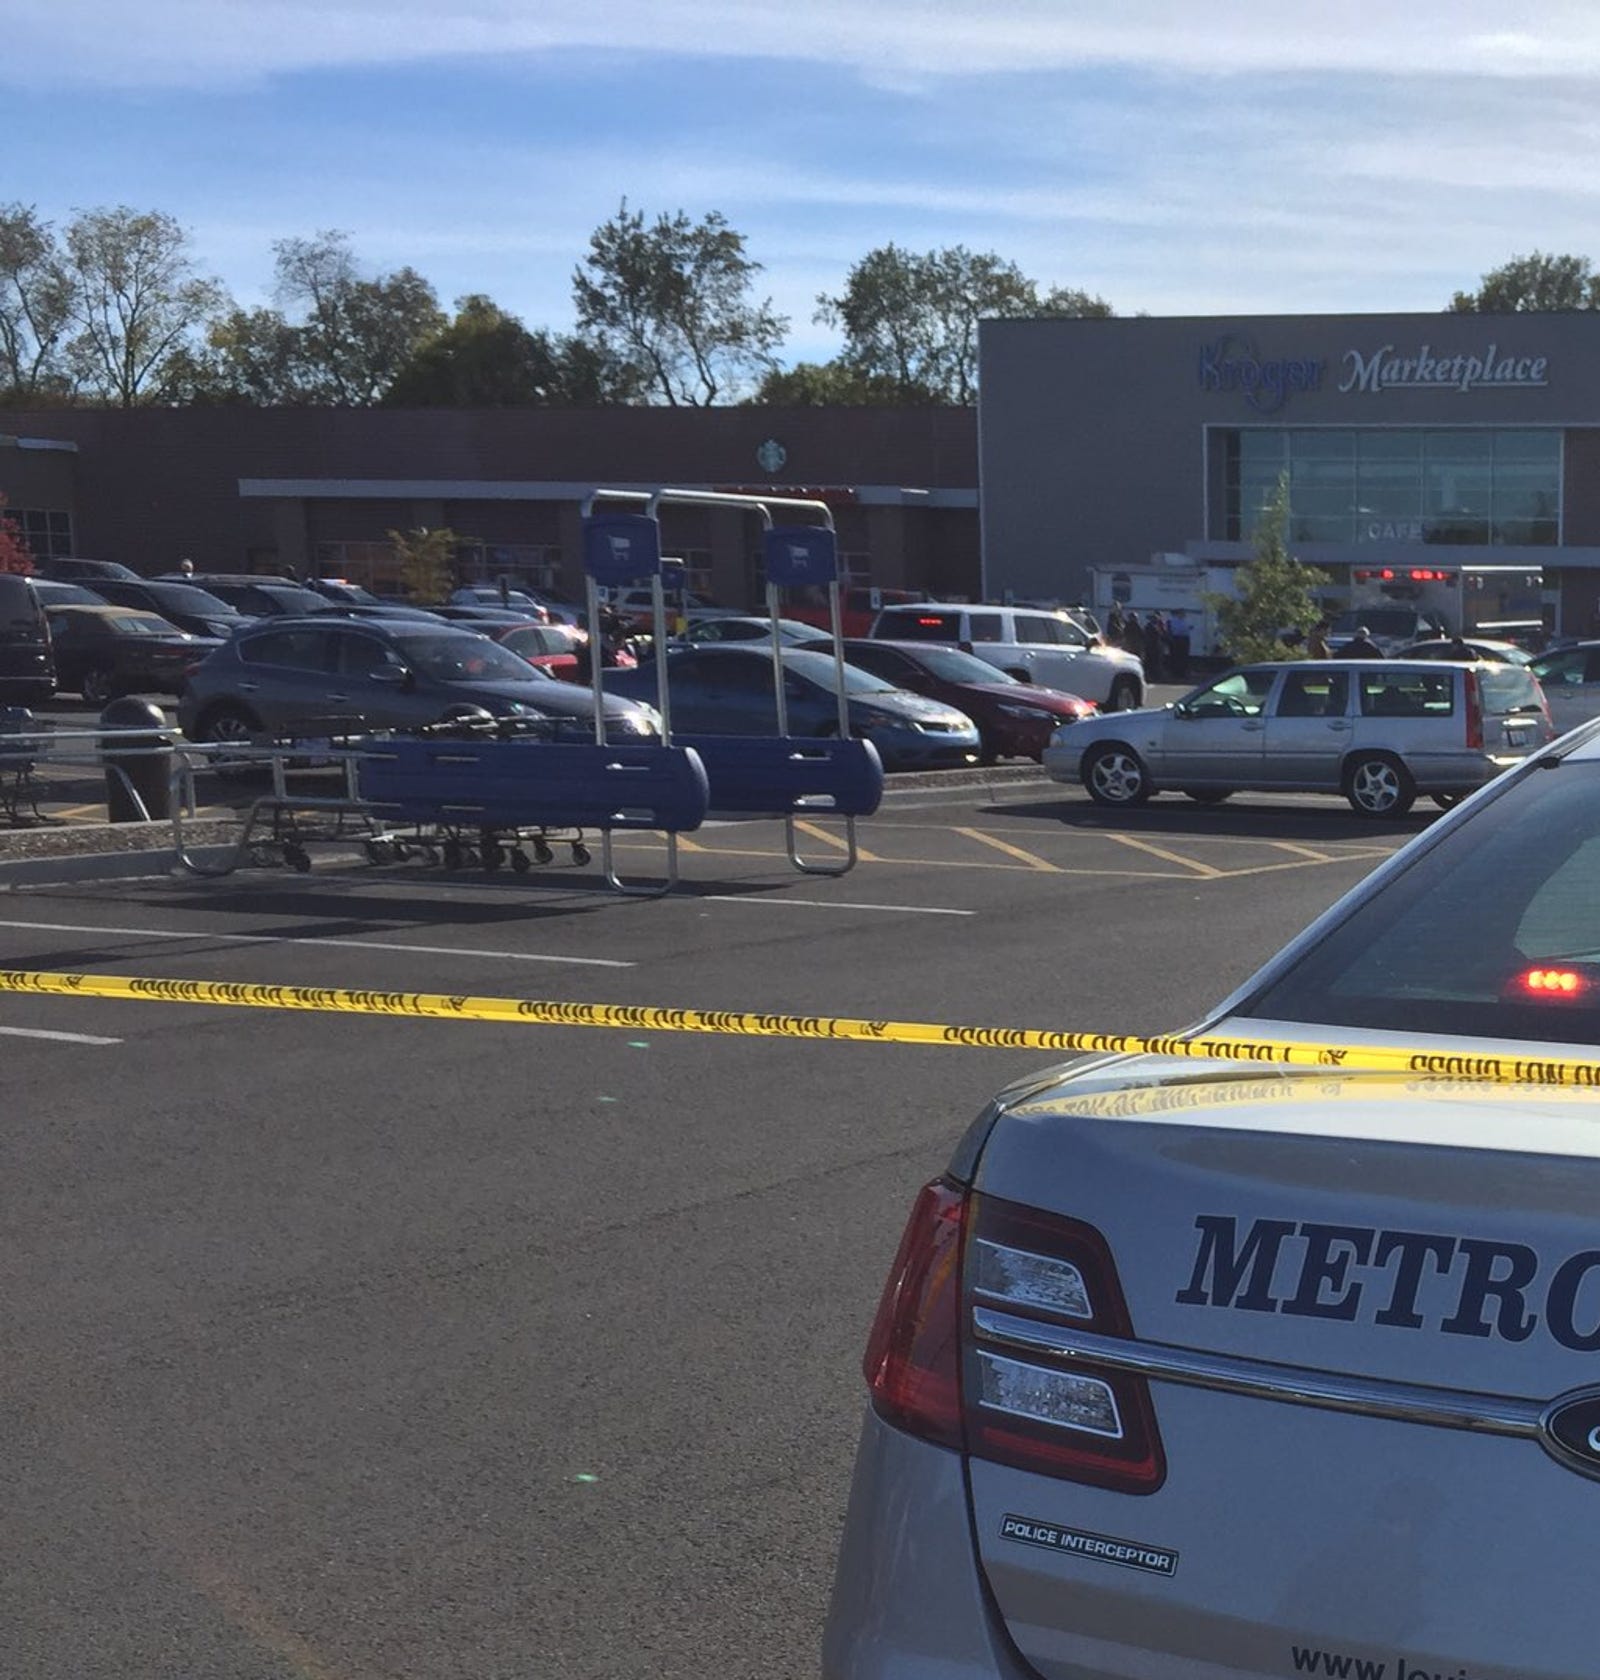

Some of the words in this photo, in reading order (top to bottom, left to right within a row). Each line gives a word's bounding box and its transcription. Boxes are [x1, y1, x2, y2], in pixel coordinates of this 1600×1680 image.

[1198, 335, 1325, 415] Kroger
[1339, 344, 1548, 393] Marketplace
[1004, 1521, 1057, 1544] POLICE
[1060, 1533, 1171, 1569] INTERCEPTOR
